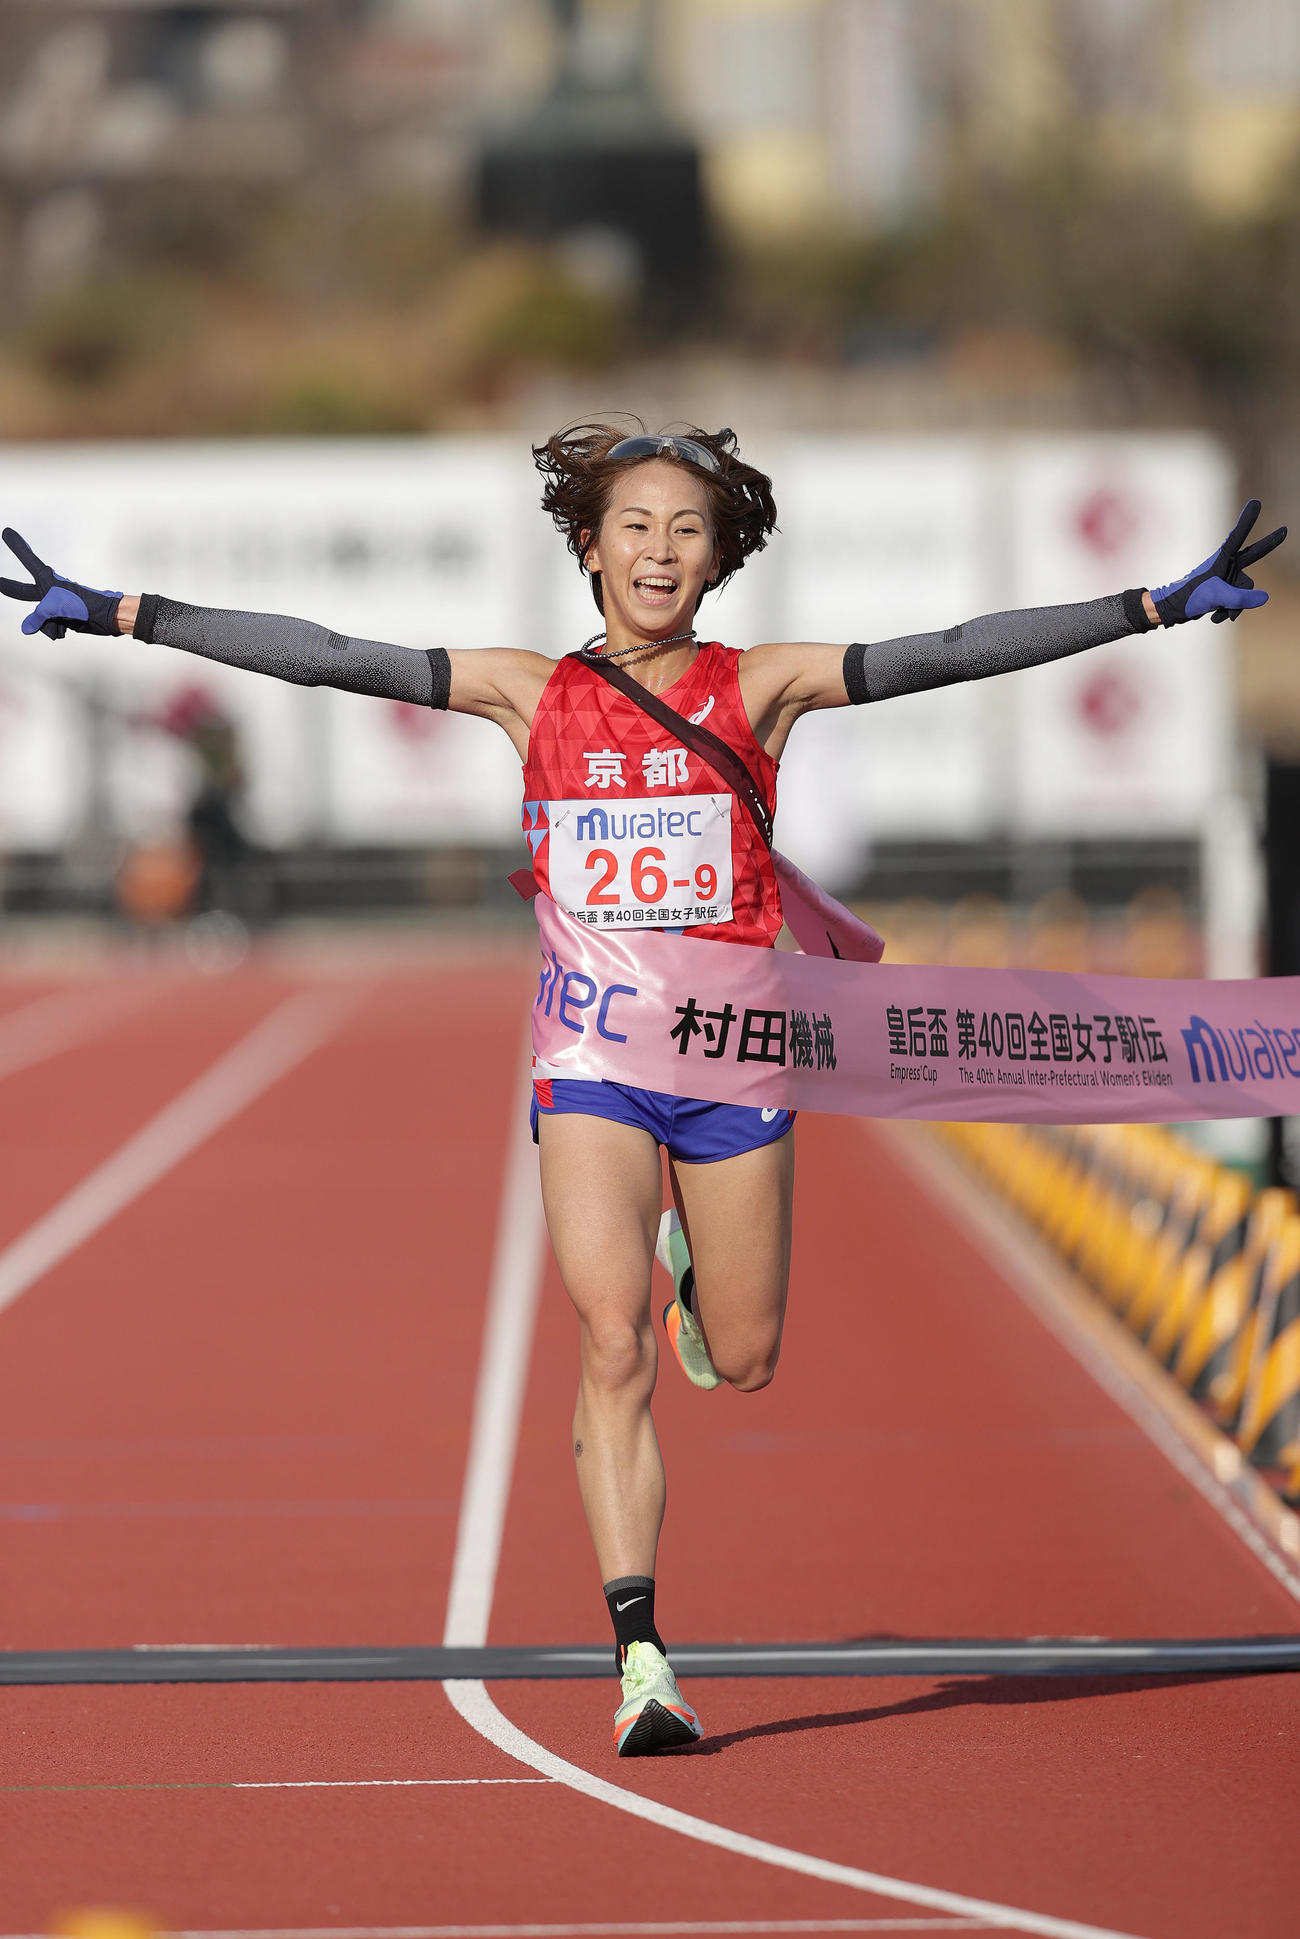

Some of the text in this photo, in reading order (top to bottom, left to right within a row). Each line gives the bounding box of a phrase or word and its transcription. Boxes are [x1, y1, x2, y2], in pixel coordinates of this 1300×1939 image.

[583, 747, 691, 789] 京都
[583, 846, 718, 906] 26-9
[602, 905, 718, 923] 第40回全国女子駅伝
[669, 997, 838, 1071] 村田機械
[886, 1004, 1168, 1063] 皇后盃 第40回全国女子駅伝
[958, 1067, 974, 1084] The
[976, 1068, 995, 1085] 40th
[997, 1069, 1025, 1085] Annual
[1027, 1069, 1099, 1087] Inter-Prefectural
[1099, 1071, 1140, 1087] Women's
[1142, 1070, 1173, 1087] Ekiden
